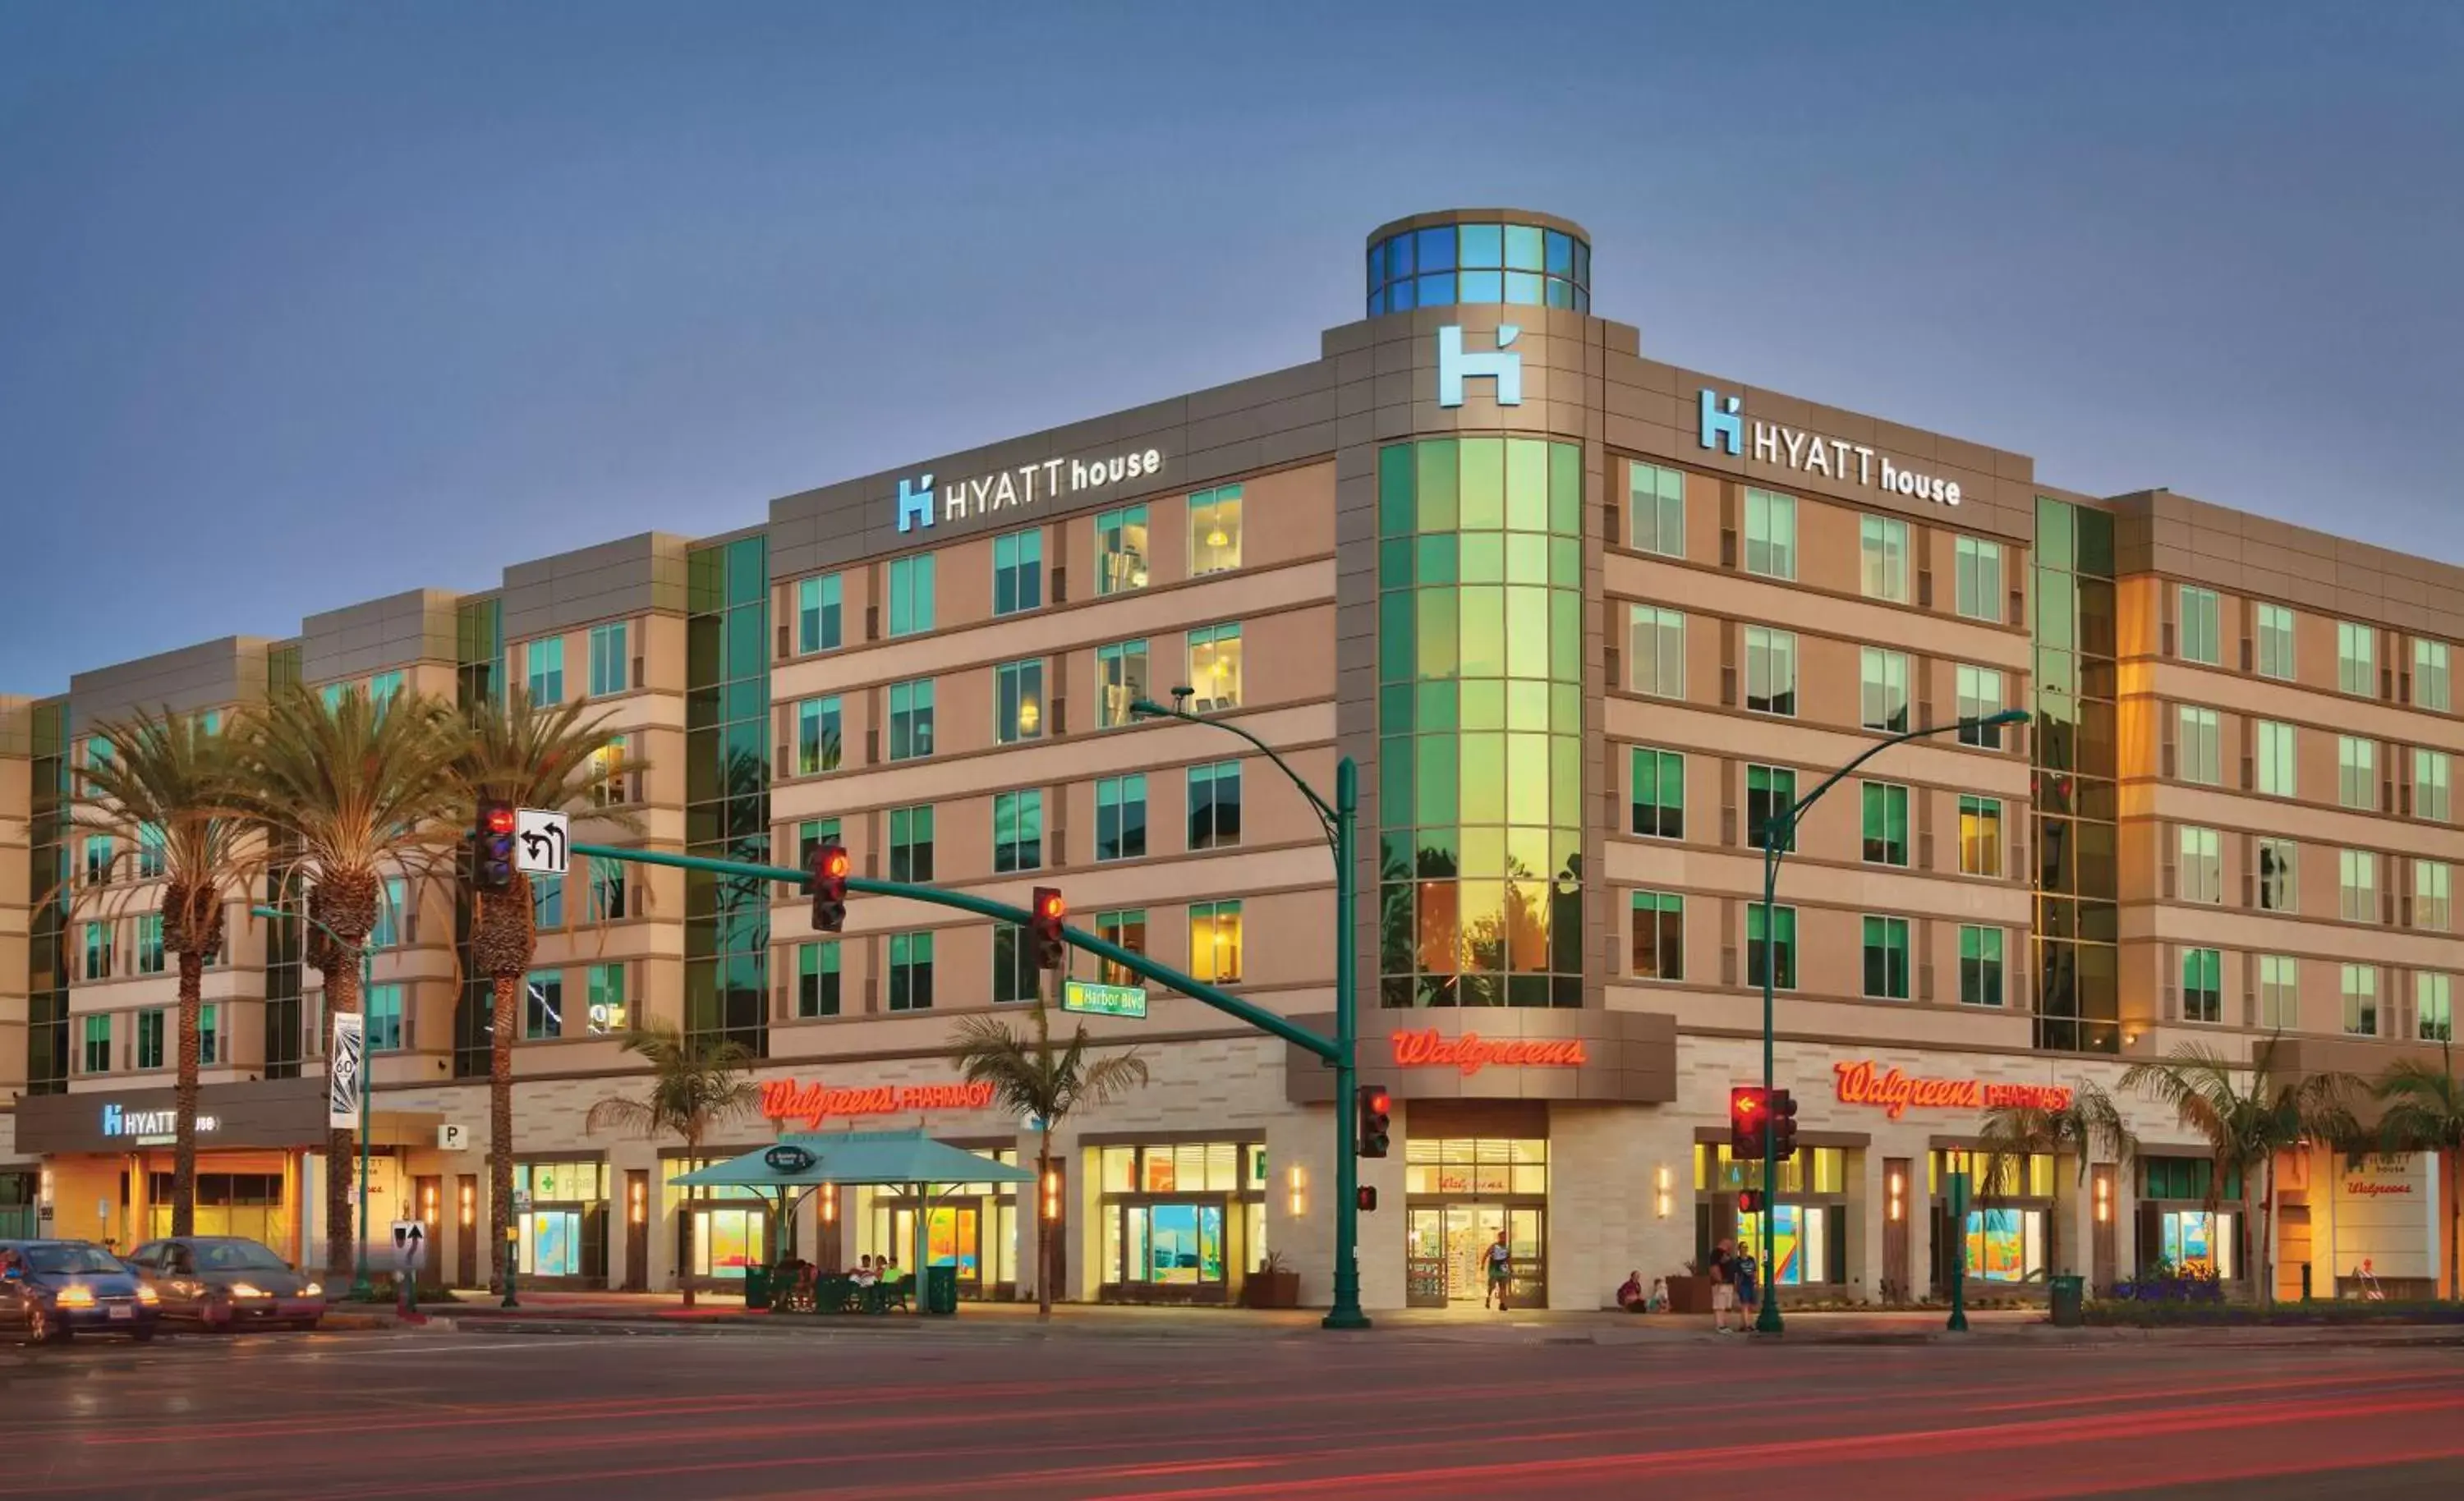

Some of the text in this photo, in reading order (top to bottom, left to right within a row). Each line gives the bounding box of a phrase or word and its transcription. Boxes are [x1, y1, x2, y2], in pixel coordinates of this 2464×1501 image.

[946, 458, 1064, 521] HYATT
[1071, 448, 1161, 490] house
[1753, 421, 1874, 485] HYATT
[1879, 457, 1961, 506] house
[1084, 988, 1118, 1006] Harbor
[1392, 1027, 1588, 1077] Walgreens
[762, 1077, 992, 1130] Walgreens PHARMACY
[1833, 1059, 2075, 1119] Walgreens PHARMACY
[125, 1111, 178, 1135] HYATT
[447, 1126, 458, 1142] P
[2347, 1182, 2413, 1197] Walgreens
